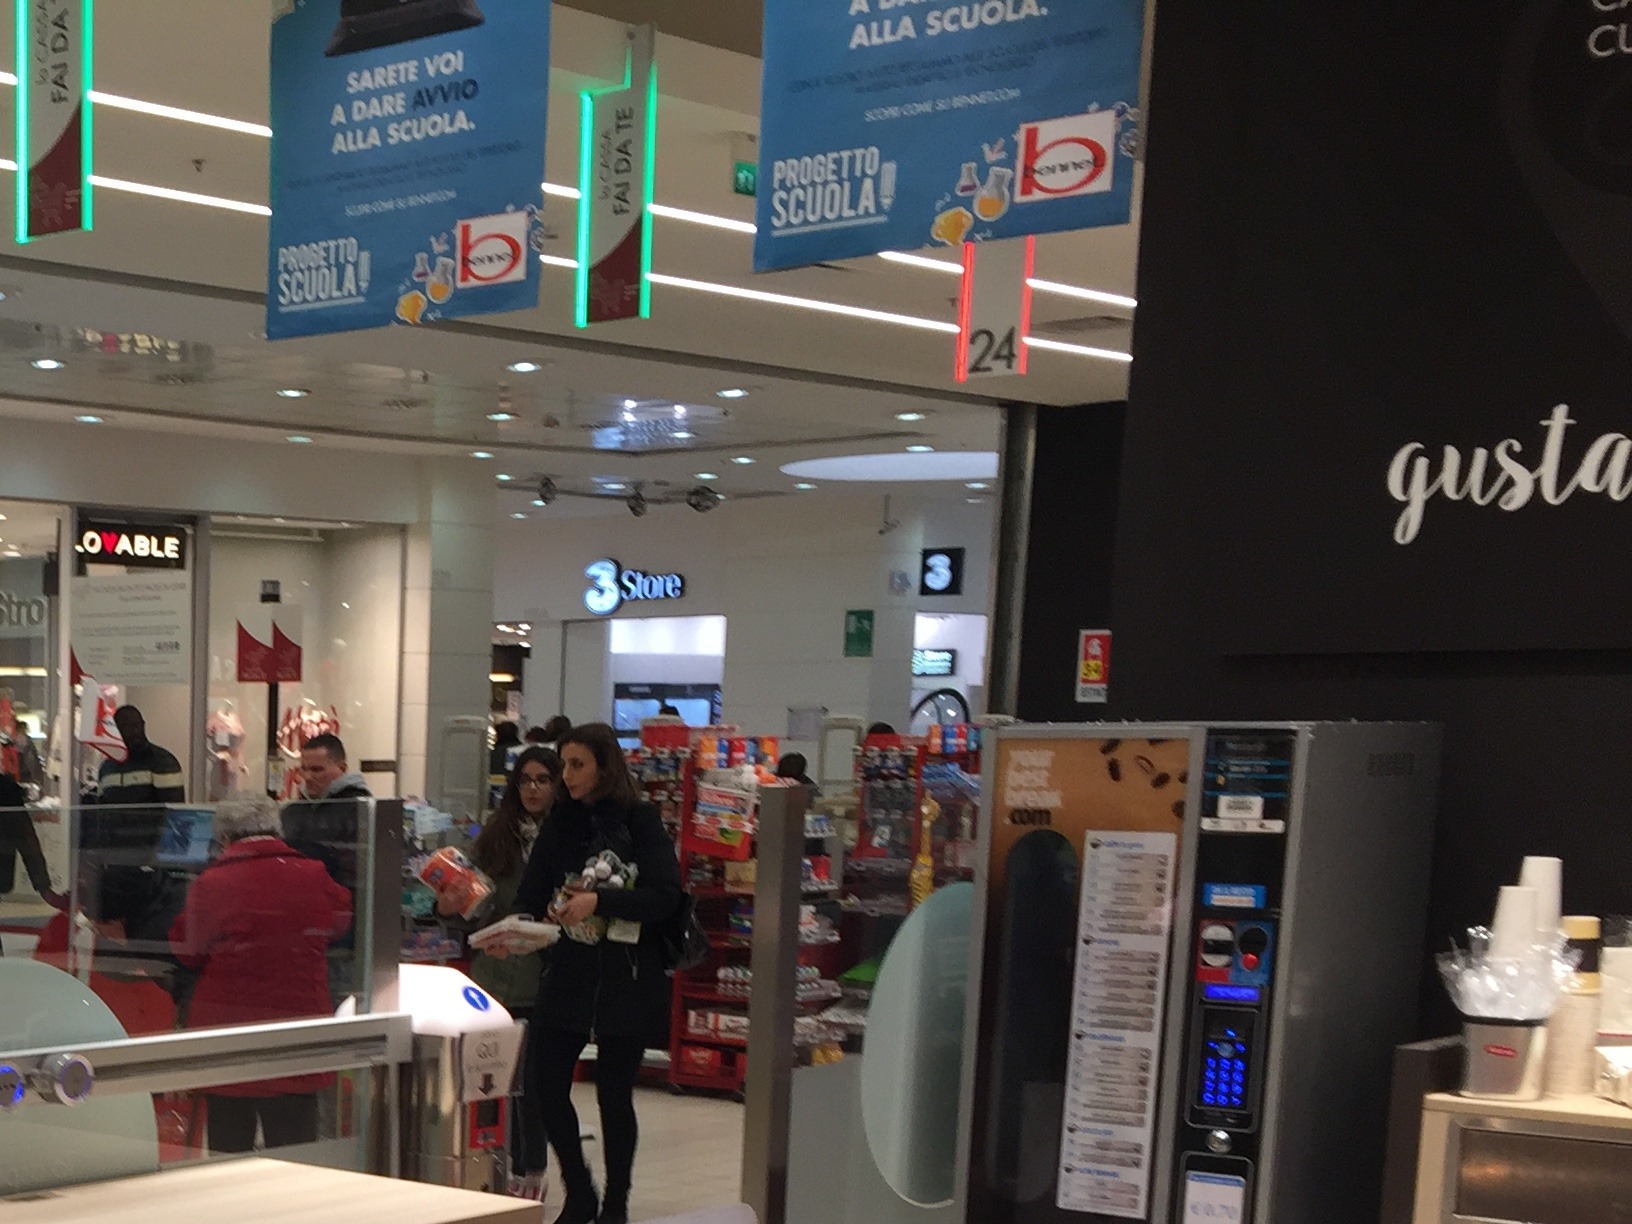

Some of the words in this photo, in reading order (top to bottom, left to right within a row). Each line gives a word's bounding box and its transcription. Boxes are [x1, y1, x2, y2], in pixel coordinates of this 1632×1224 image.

[849, 15, 917, 49] ALLA
[925, 0, 1049, 36] SCUOLA.
[346, 59, 419, 94] SARETE
[424, 50, 464, 78] VOI
[330, 103, 347, 126] A
[351, 92, 407, 122] DARE
[411, 78, 480, 111] AVVIO
[331, 126, 382, 154] ALLA
[386, 109, 476, 145] SCUOLA.
[614, 139, 632, 174] DA
[773, 145, 880, 190] PROGETTO
[278, 236, 358, 273] PROGETTO
[969, 327, 1016, 374] 24
[1387, 403, 1632, 545] gusta
[583, 558, 621, 615] 3
[621, 569, 682, 600] Store
[924, 553, 953, 591] 3
